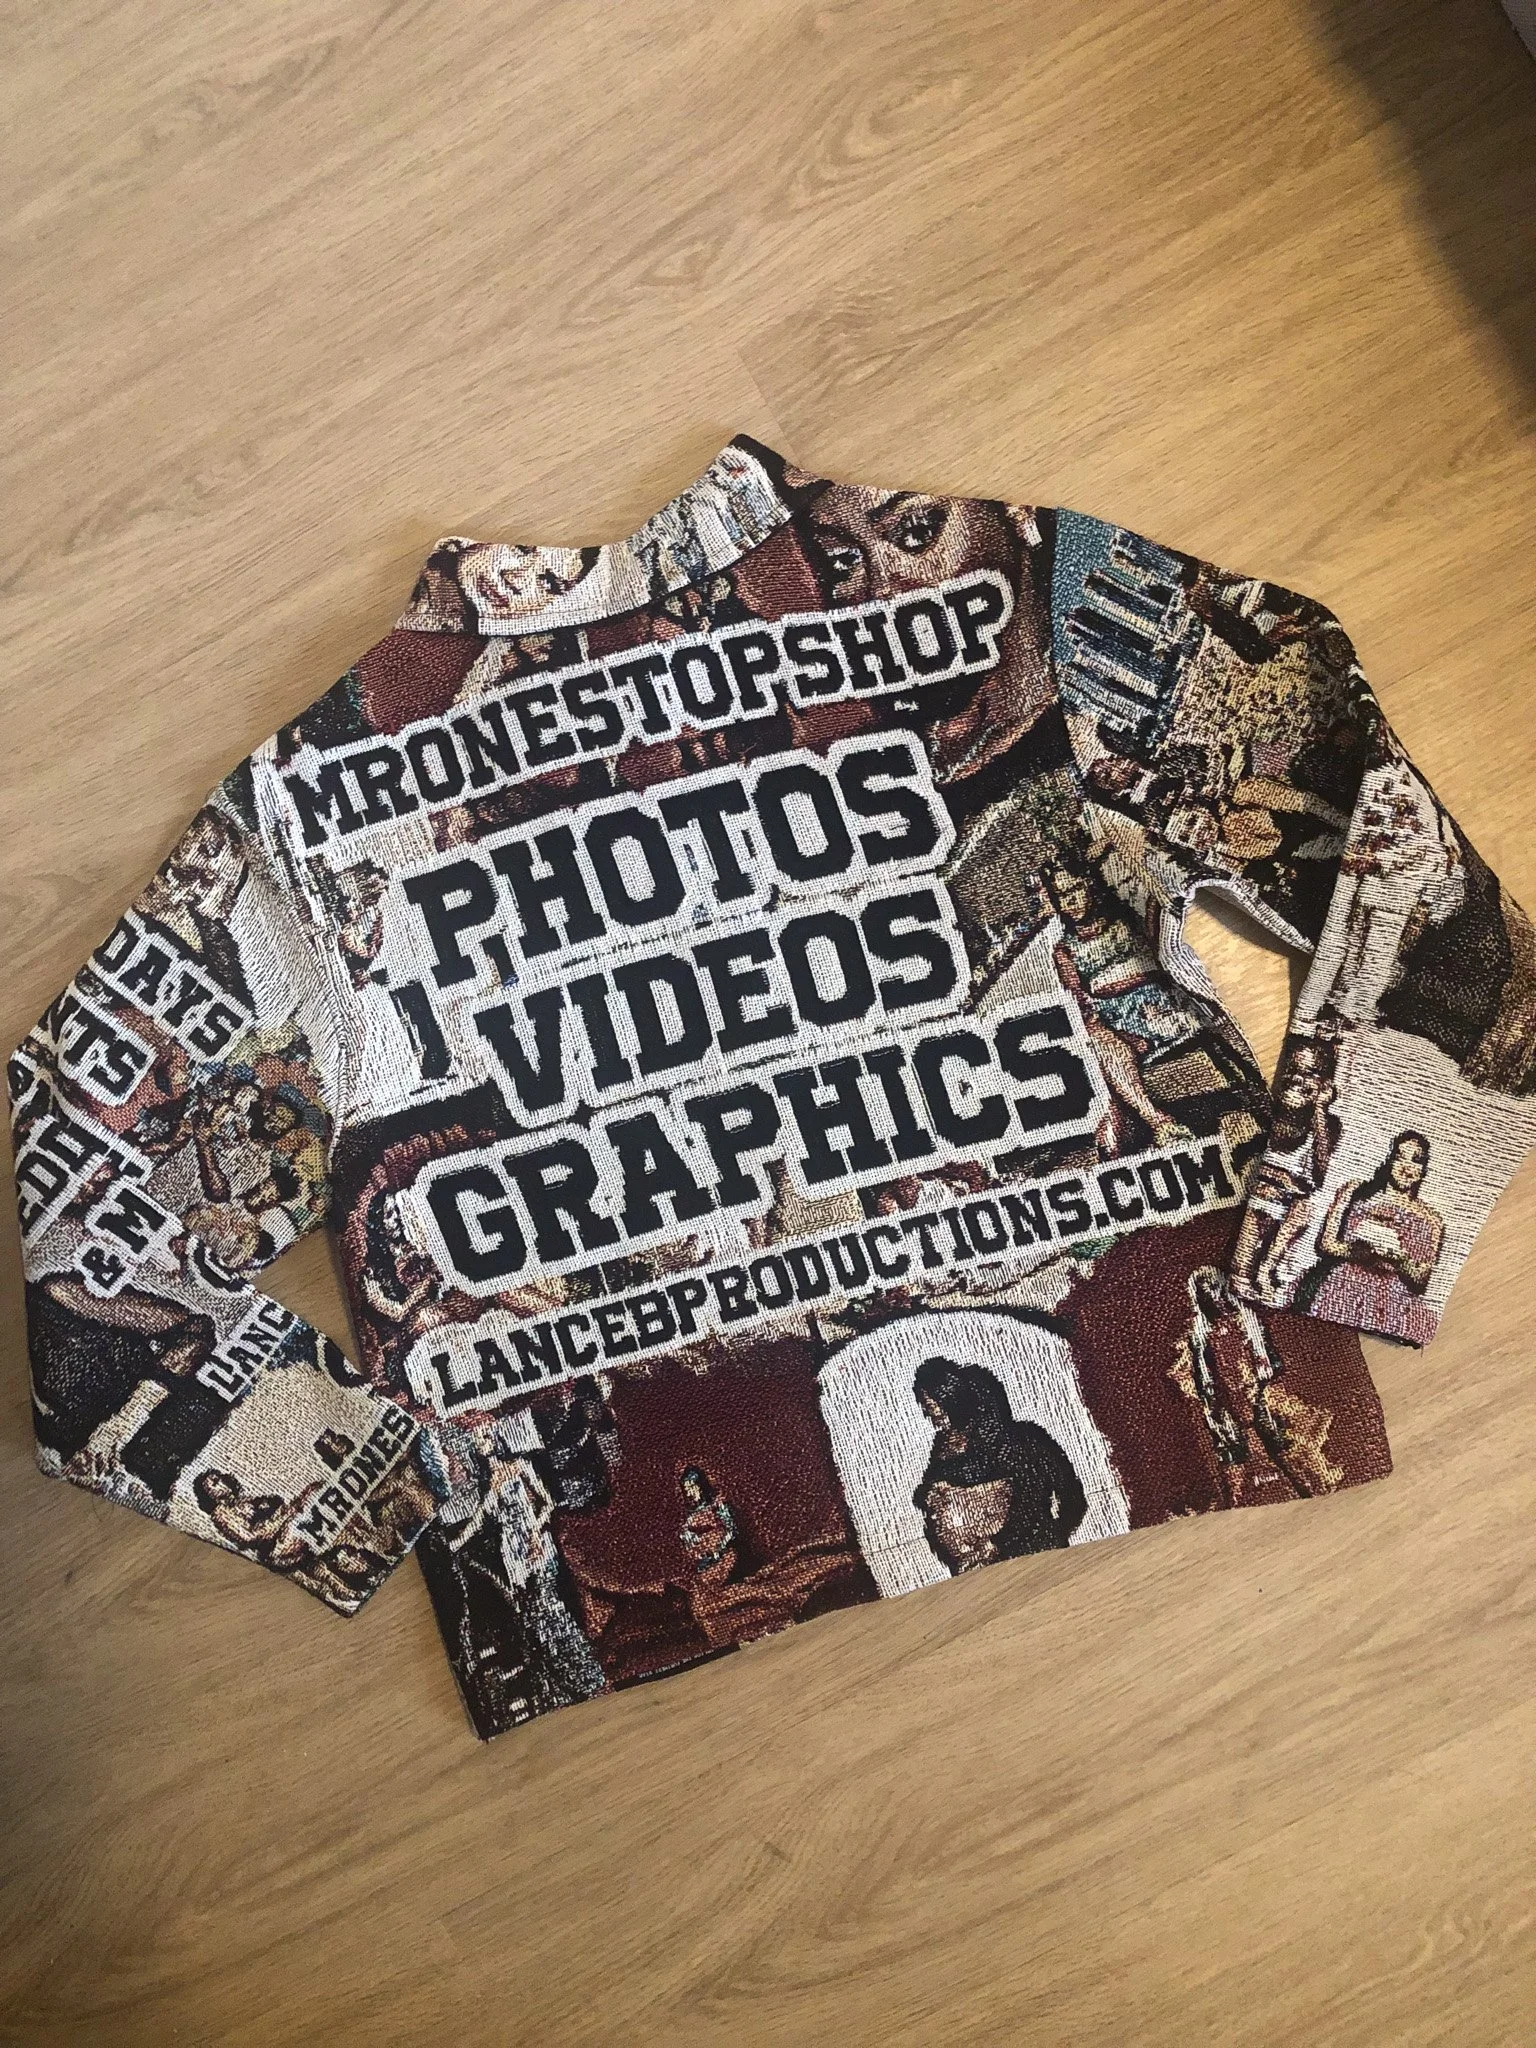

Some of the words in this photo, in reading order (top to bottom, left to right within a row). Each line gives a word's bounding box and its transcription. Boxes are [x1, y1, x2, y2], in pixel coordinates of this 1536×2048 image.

[284, 585, 1004, 848] MRONESTOPSHOP
[93, 915, 244, 1057] DAYS
[403, 747, 940, 989] PHOTOS
[475, 893, 960, 1109] VIDEOS
[428, 1006, 1095, 1283] GRAPHICS
[432, 1143, 1235, 1404] LANCEBPRODUCTIONS.COM
